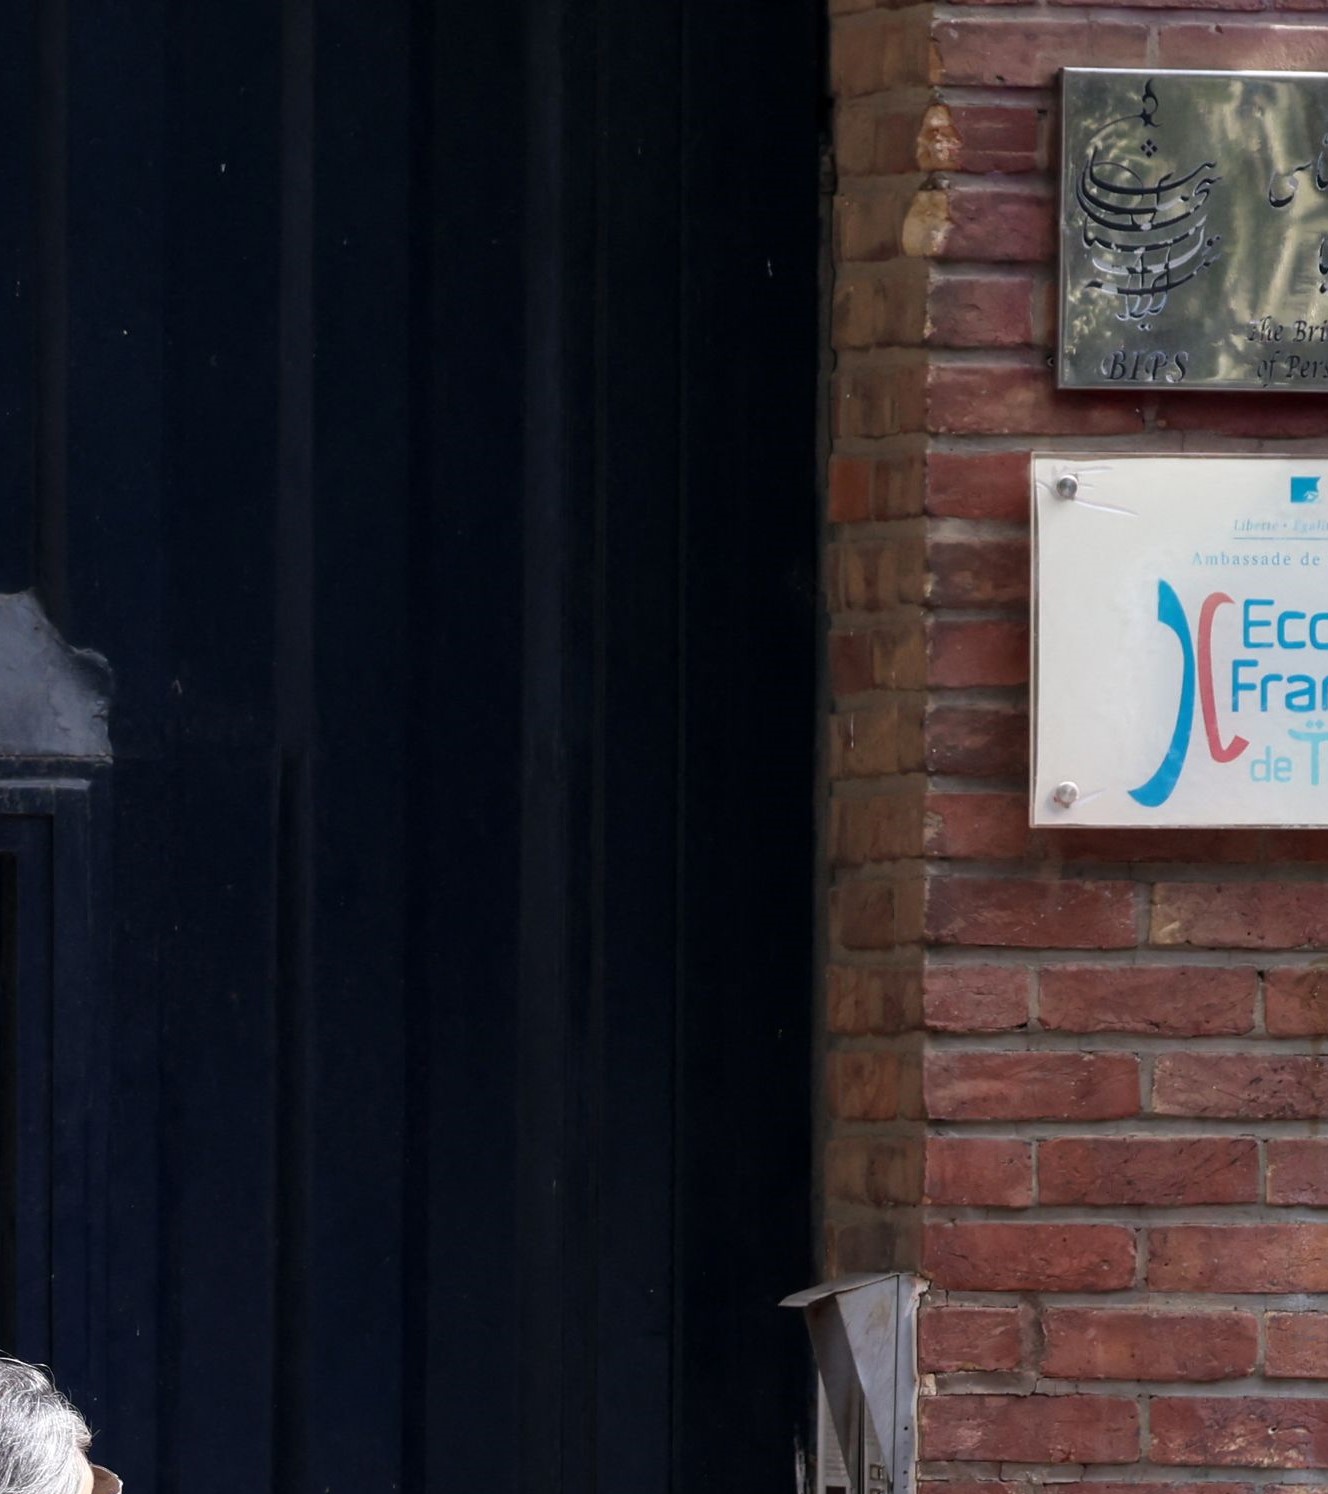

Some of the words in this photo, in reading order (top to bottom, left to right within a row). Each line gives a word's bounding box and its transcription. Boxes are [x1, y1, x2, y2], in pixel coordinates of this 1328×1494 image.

[1102, 350, 1190, 382] BIPS
[1256, 351, 1280, 387] of
[1191, 551, 1292, 567] Ambassade
[1300, 551, 1321, 567] de
[1249, 745, 1294, 783] de
